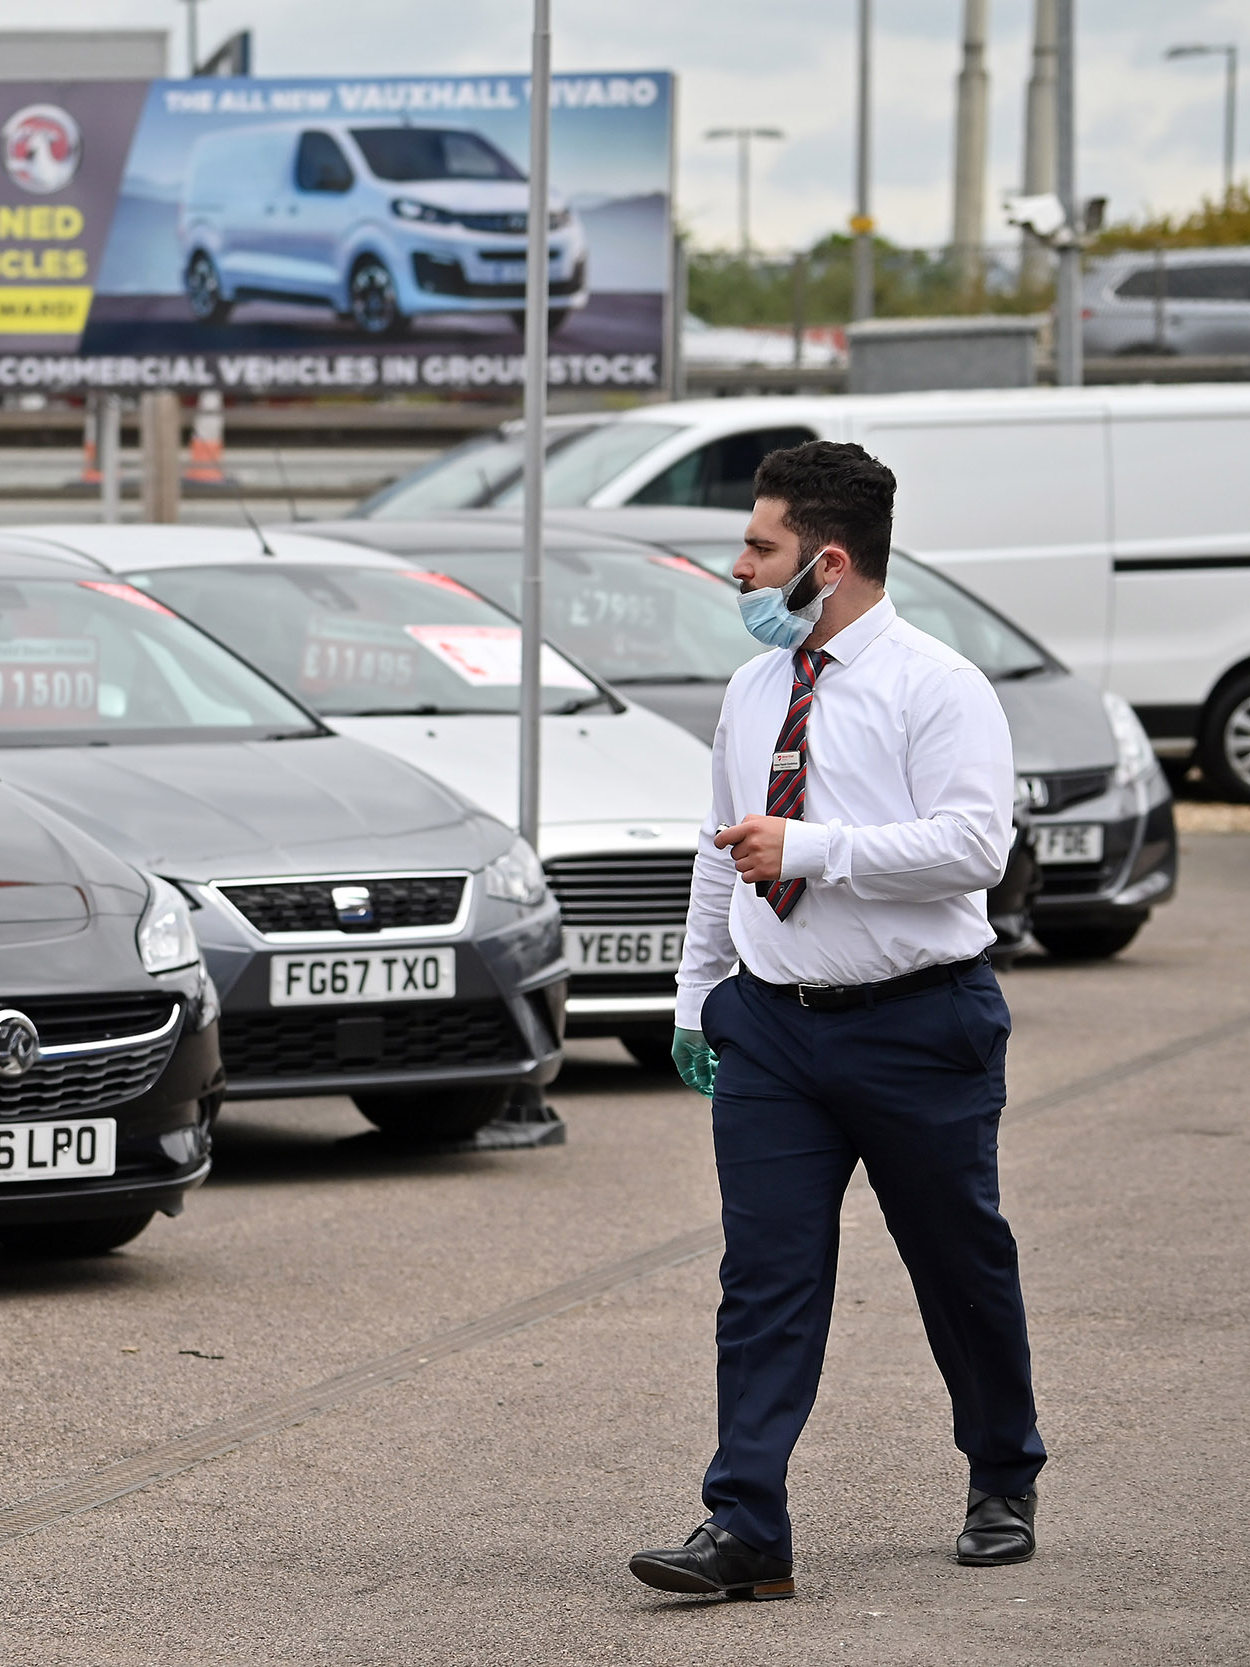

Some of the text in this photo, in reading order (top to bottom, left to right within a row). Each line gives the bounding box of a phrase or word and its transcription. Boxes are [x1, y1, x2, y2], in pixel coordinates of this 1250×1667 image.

[165, 89, 213, 112] THE
[218, 88, 264, 111] ALL
[270, 88, 328, 110] NEW
[337, 82, 517, 110] VAUXHALL
[218, 355, 378, 385] VEHICLES
[383, 355, 418, 384] IN
[422, 354, 528, 384] GROU
[548, 353, 658, 384] STOCK
[579, 932, 652, 964] YE66
[285, 956, 440, 996] FG67 TXO
[27, 1126, 97, 1168] LPO
